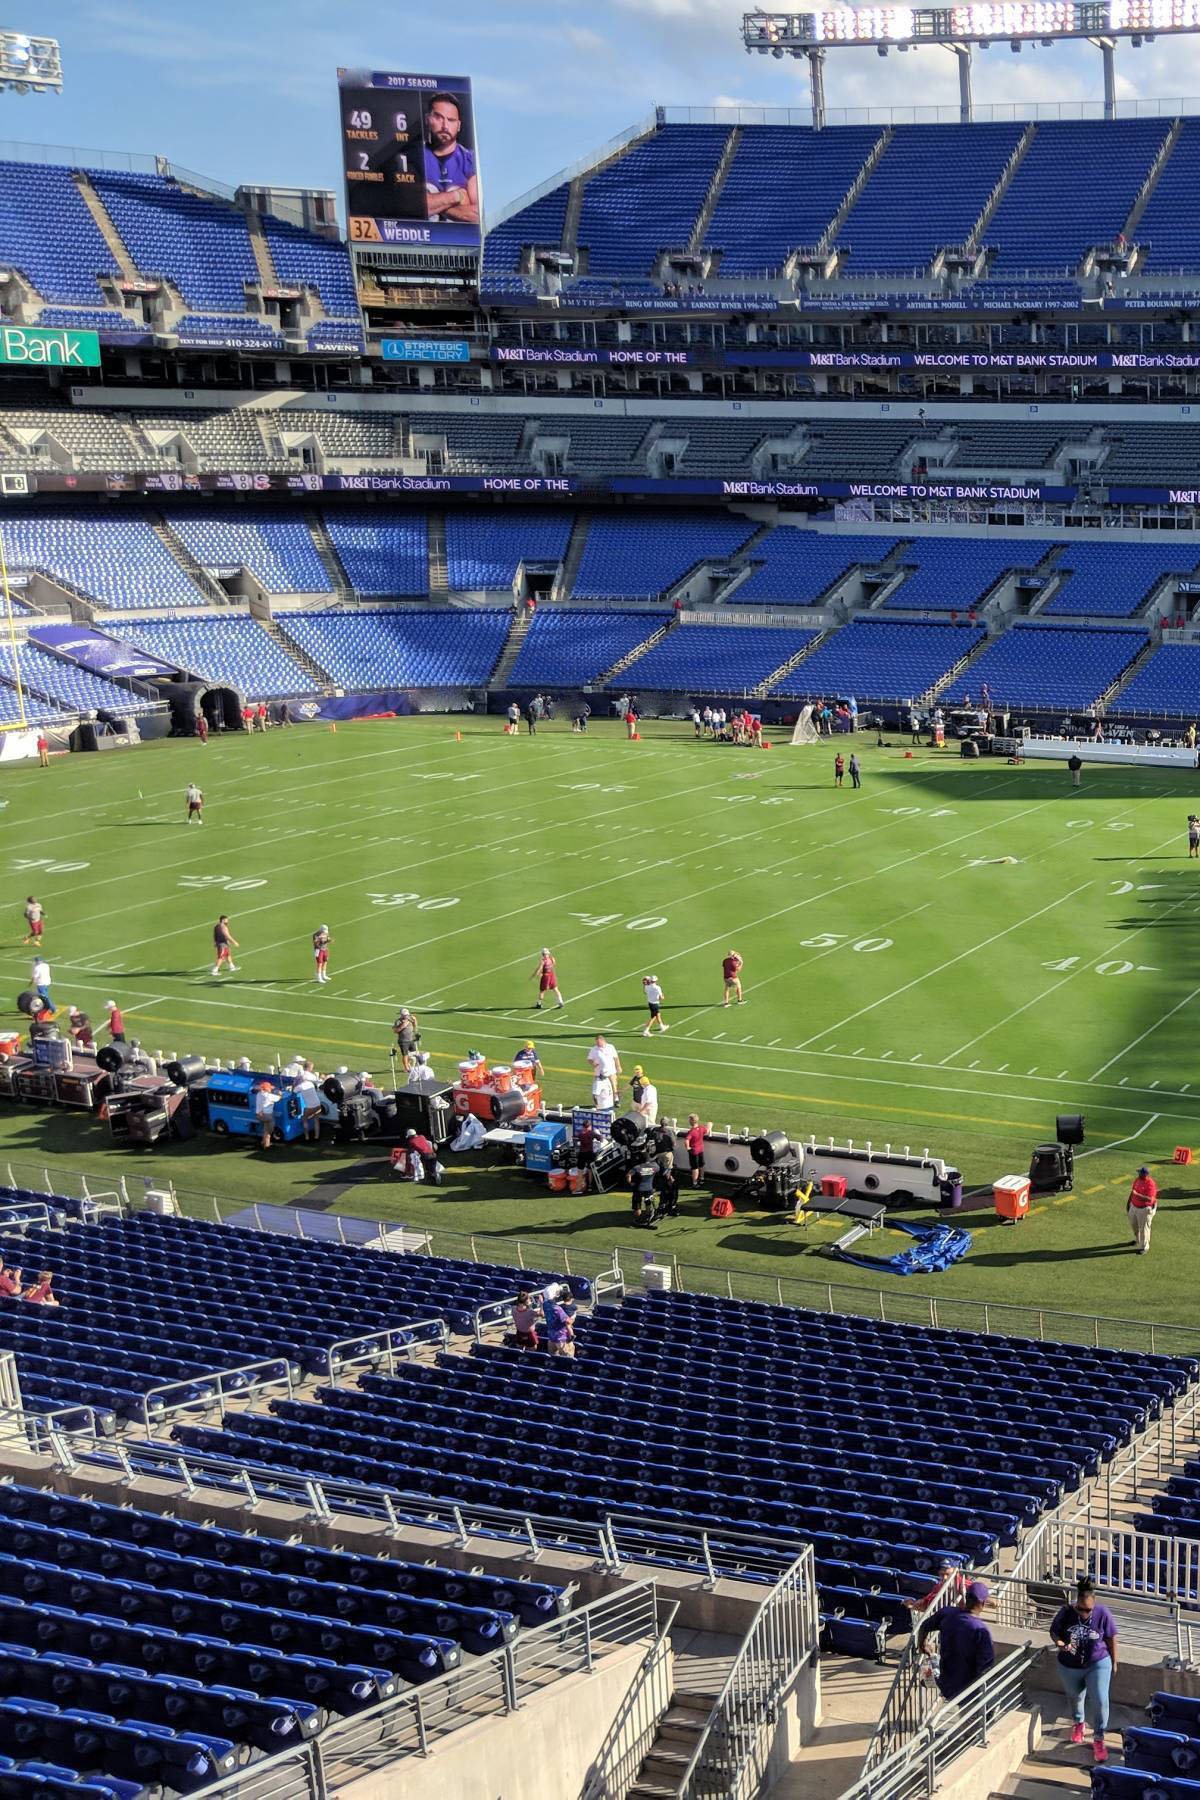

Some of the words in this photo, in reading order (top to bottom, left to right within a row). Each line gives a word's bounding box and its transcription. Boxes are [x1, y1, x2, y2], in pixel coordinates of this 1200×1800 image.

[388, 76, 406, 86] 2017
[408, 77, 438, 88] SEASON
[351, 111, 372, 129] 49
[396, 114, 407, 131] 6
[346, 130, 378, 140] TACKLES
[359, 152, 370, 170] 2
[400, 155, 408, 172] 1
[396, 174, 416, 183] SACK
[354, 220, 372, 238] 32
[384, 220, 398, 229] ERIC
[384, 229, 431, 242] WEDDLE
[626, 300, 642, 308] RING
[4, 329, 84, 364] Bank
[315, 343, 360, 352] RAVENS
[404, 342, 463, 350] STRATEGIC
[405, 350, 463, 360] FACTORY
[498, 348, 526, 361] M&T
[527, 350, 553, 361] Bank
[554, 349, 598, 362] Stadium
[609, 352, 642, 362] HOME
[646, 352, 661, 362] OF
[666, 352, 687, 363] THE
[810, 354, 836, 365] M&T
[836, 354, 860, 365] Bank
[861, 354, 900, 365] Stadium
[914, 355, 969, 365] WELCOME
[972, 355, 988, 365] TO
[990, 355, 1014, 365] M&T
[1016, 355, 1046, 365] BANK
[1049, 355, 1097, 366] STADIUM
[1112, 354, 1138, 366] M&T
[1139, 354, 1165, 366] Bank
[340, 477, 371, 488] M&T
[372, 477, 400, 489] Bank
[402, 477, 450, 489] Stadium
[483, 479, 521, 489] HOME
[524, 479, 541, 489] OF
[544, 479, 569, 490] THE
[723, 482, 751, 494] M&T
[751, 482, 776, 494] Bank
[776, 482, 818, 495] Stadium
[850, 484, 908, 496] WELCOME
[910, 486, 926, 497] TO
[929, 486, 953, 497] M&T
[956, 486, 987, 497] BANK
[990, 487, 1040, 498] STADIUM
[1168, 490, 1197, 502] M&T
[177, 874, 268, 892] 20
[369, 892, 461, 910] 30
[576, 912, 669, 931] 40
[800, 932, 894, 952] 50
[1041, 956, 1134, 976] 40
[456, 1094, 469, 1111] G
[1175, 1149, 1186, 1162] 30
[1017, 1190, 1028, 1207] G
[714, 1199, 727, 1215] 40
